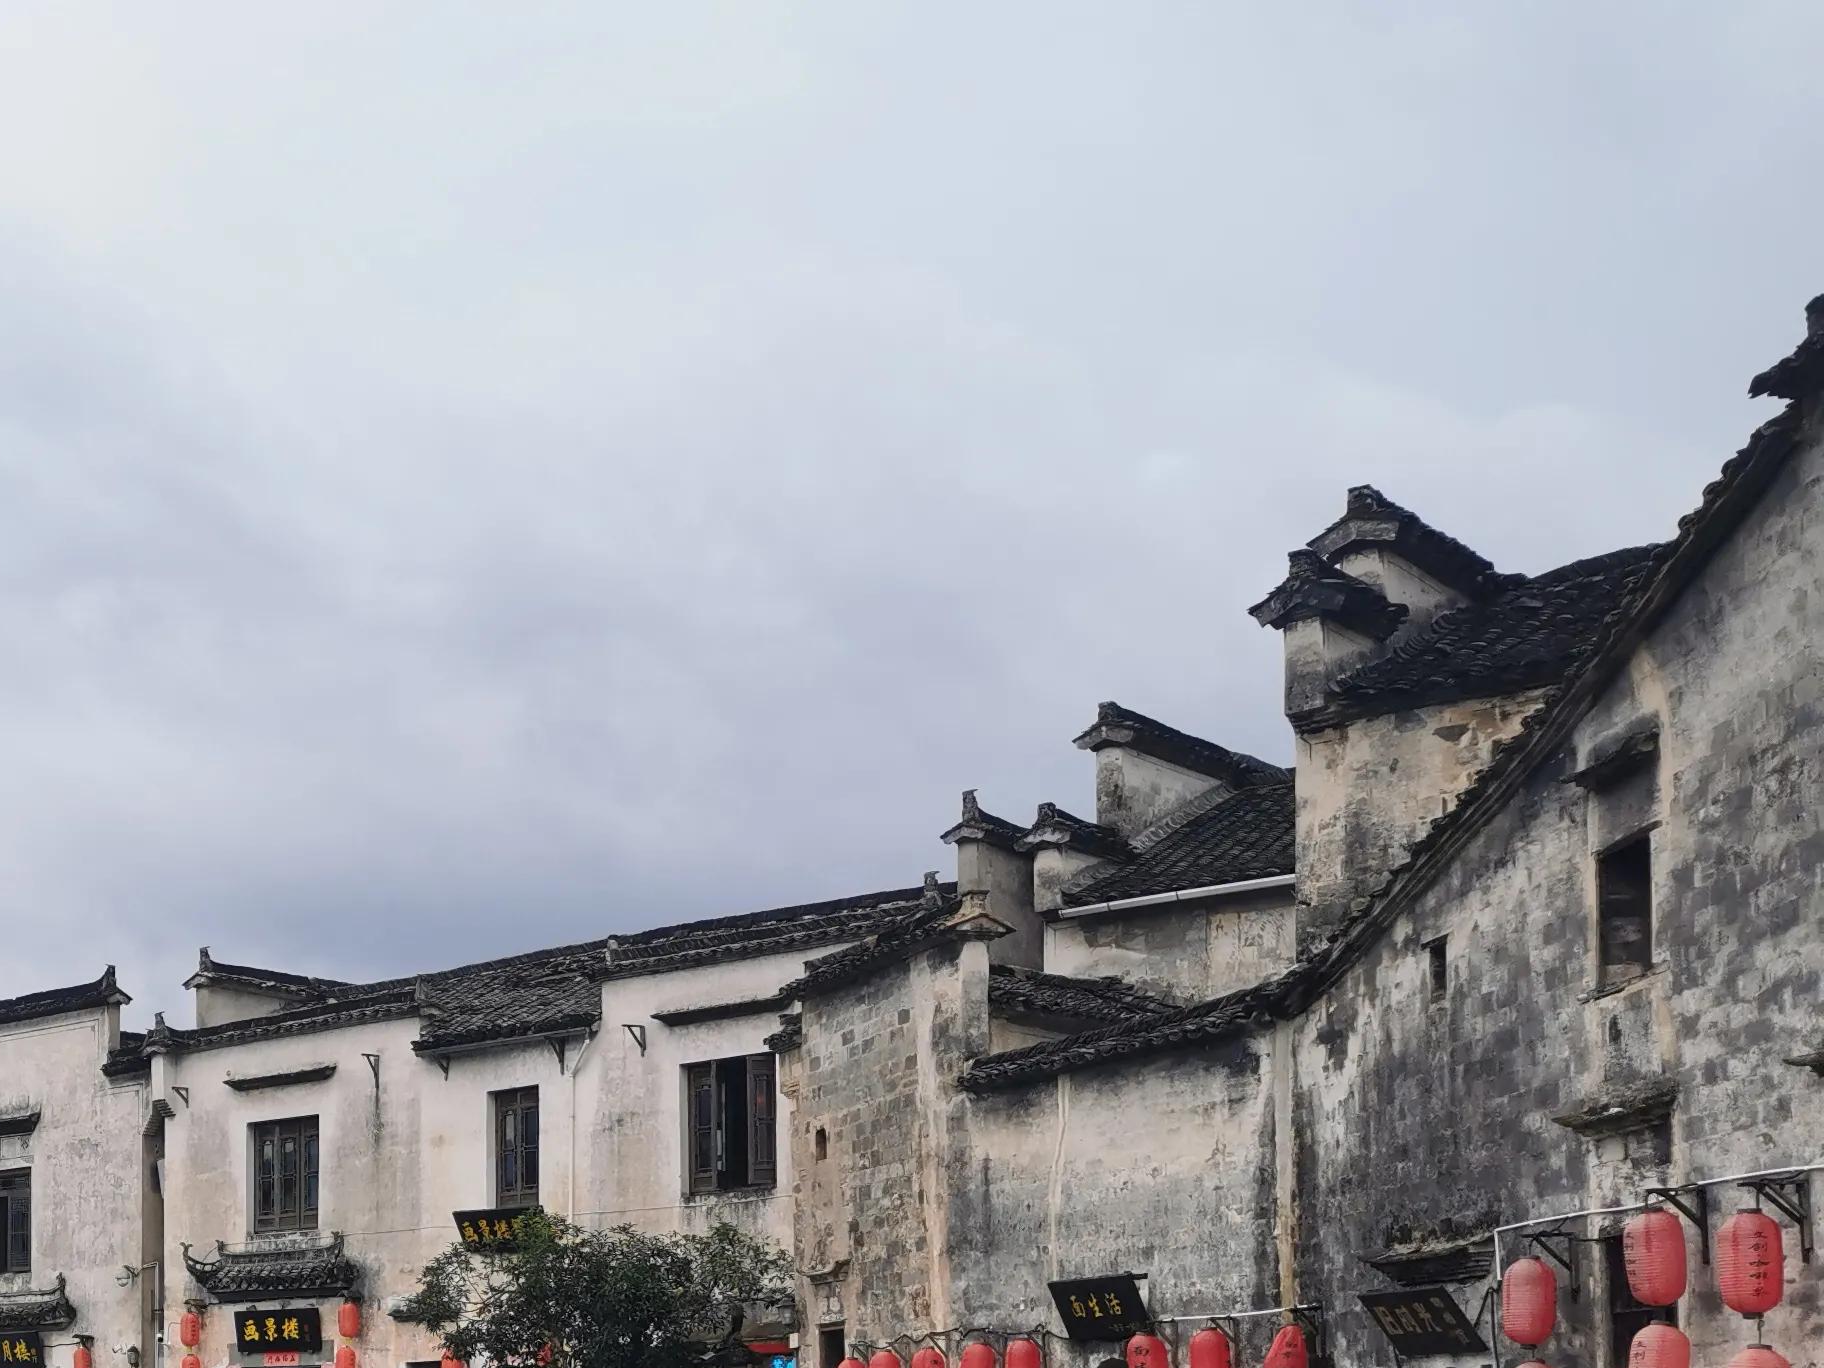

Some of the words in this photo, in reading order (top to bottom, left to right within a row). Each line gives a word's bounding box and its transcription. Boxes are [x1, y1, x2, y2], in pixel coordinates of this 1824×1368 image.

[1069, 1292, 1123, 1318] 面生活
[243, 1316, 300, 1342] 画景楼
